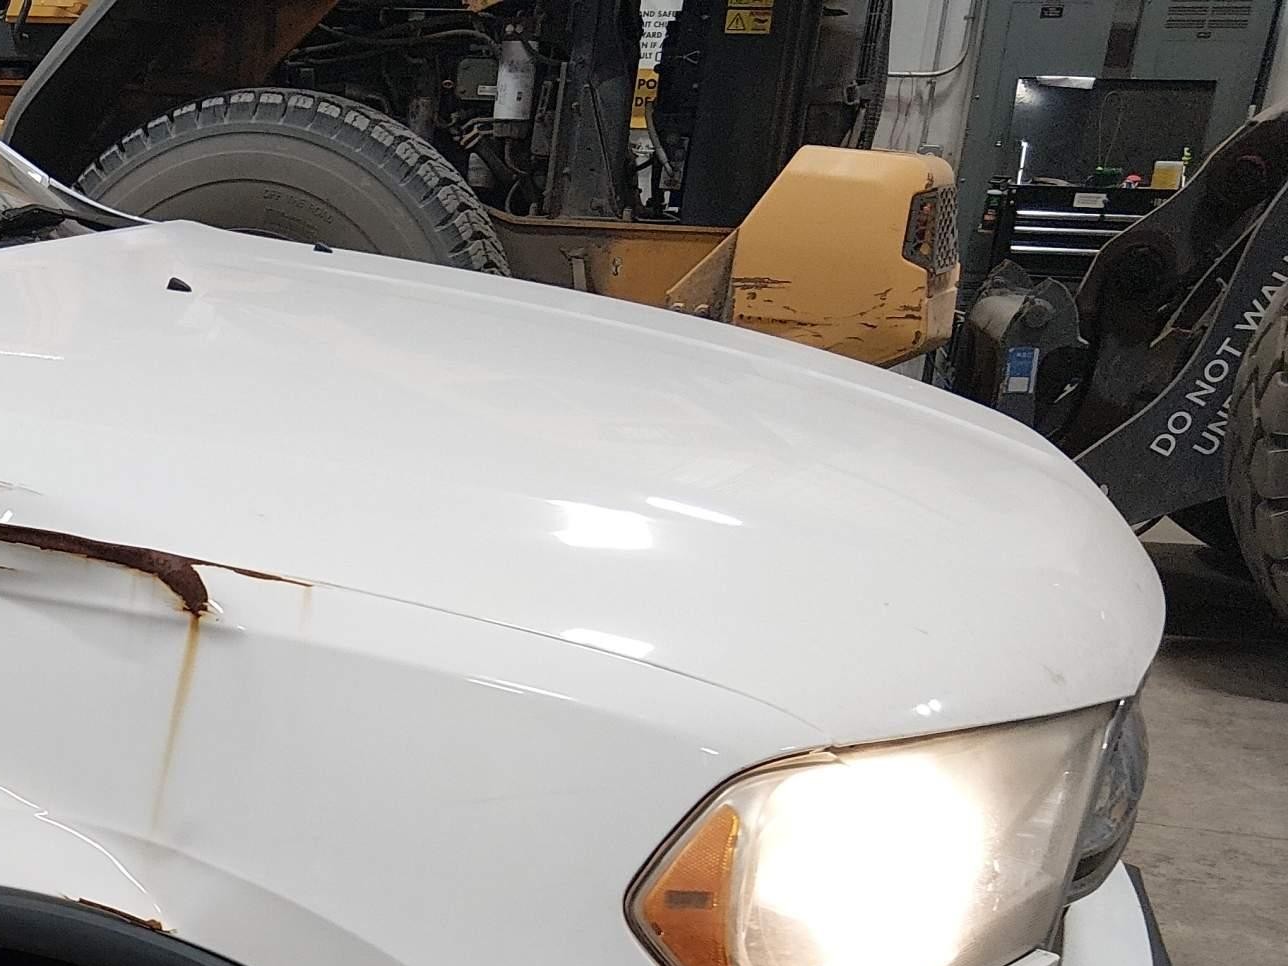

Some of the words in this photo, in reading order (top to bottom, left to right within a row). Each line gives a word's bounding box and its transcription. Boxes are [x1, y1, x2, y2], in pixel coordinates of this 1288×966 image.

[1149, 410, 1193, 457] DO
[1184, 336, 1243, 407] NOT
[1233, 254, 1288, 332] WA
